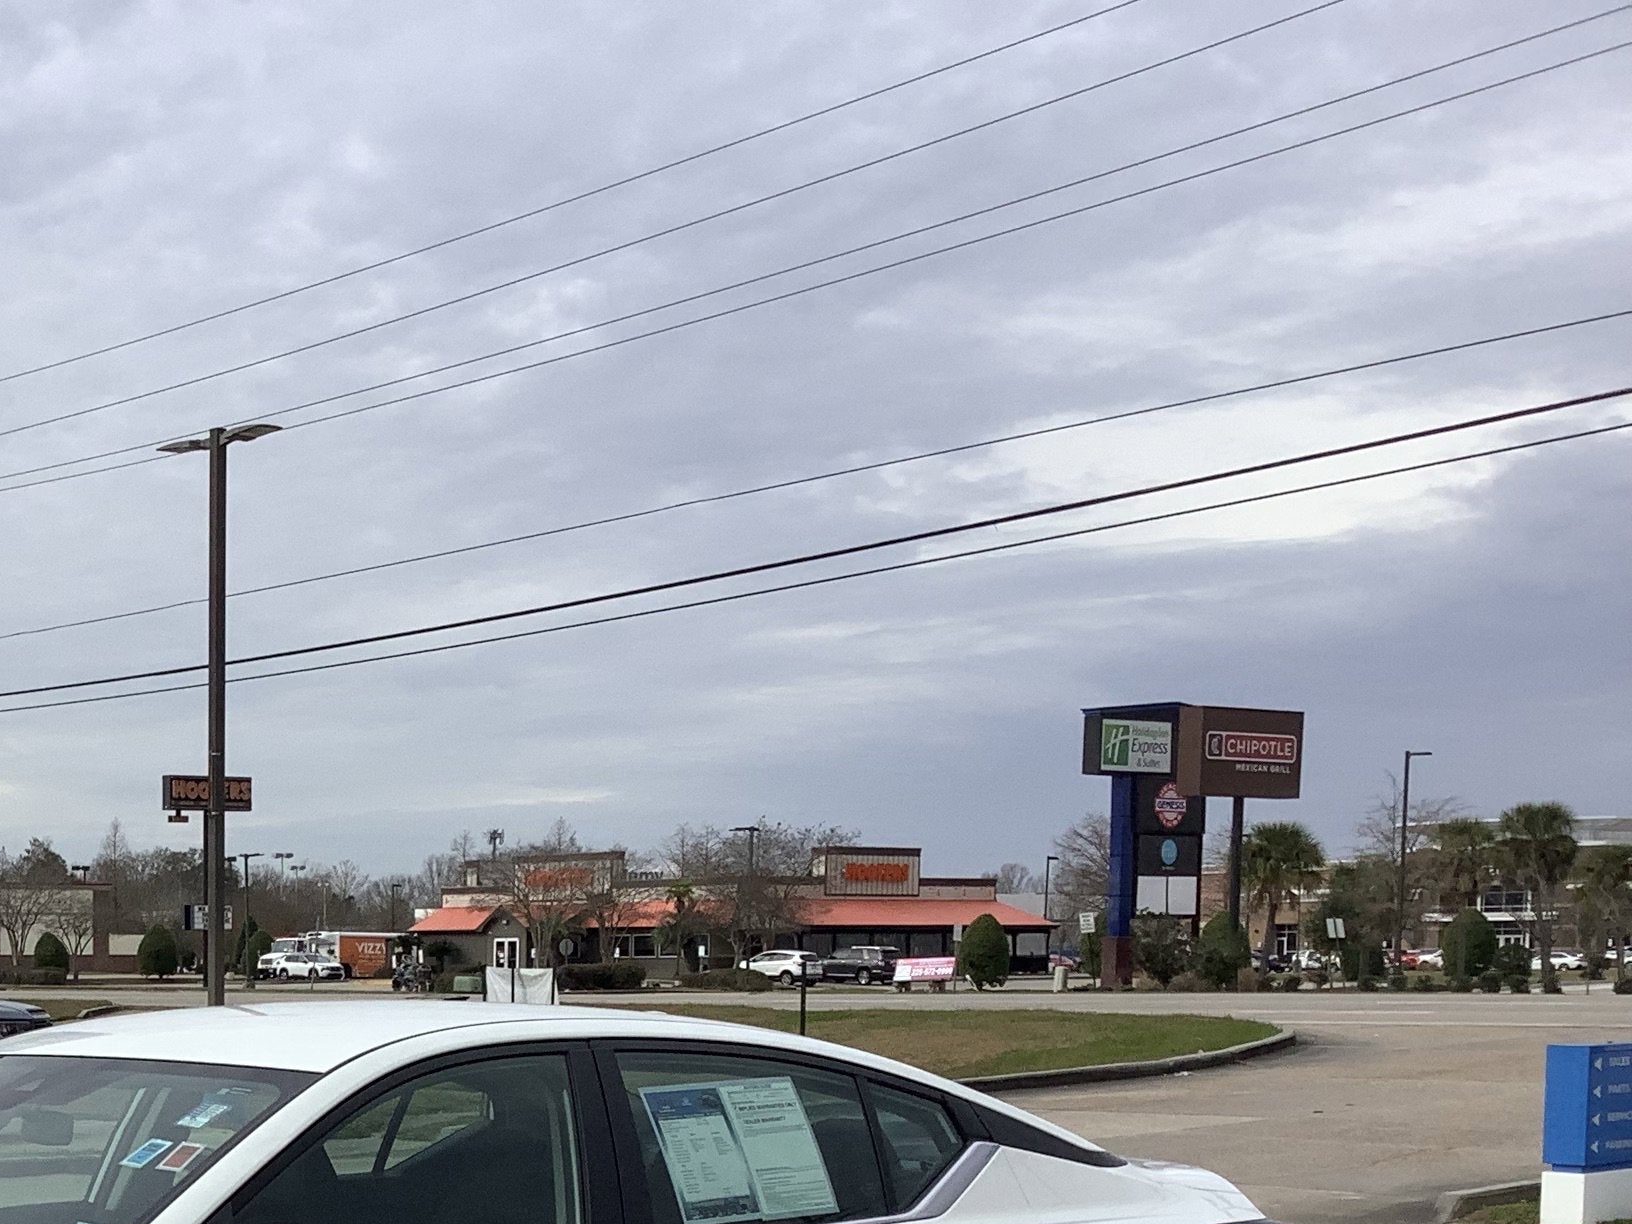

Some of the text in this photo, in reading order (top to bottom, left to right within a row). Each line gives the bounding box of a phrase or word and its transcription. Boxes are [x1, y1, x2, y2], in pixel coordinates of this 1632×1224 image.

[1131, 737, 1169, 757] Express
[1227, 738, 1293, 756] CHIPOTLE
[1235, 763, 1291, 773] MEXICAN GRILL
[172, 778, 250, 800] HOOERS
